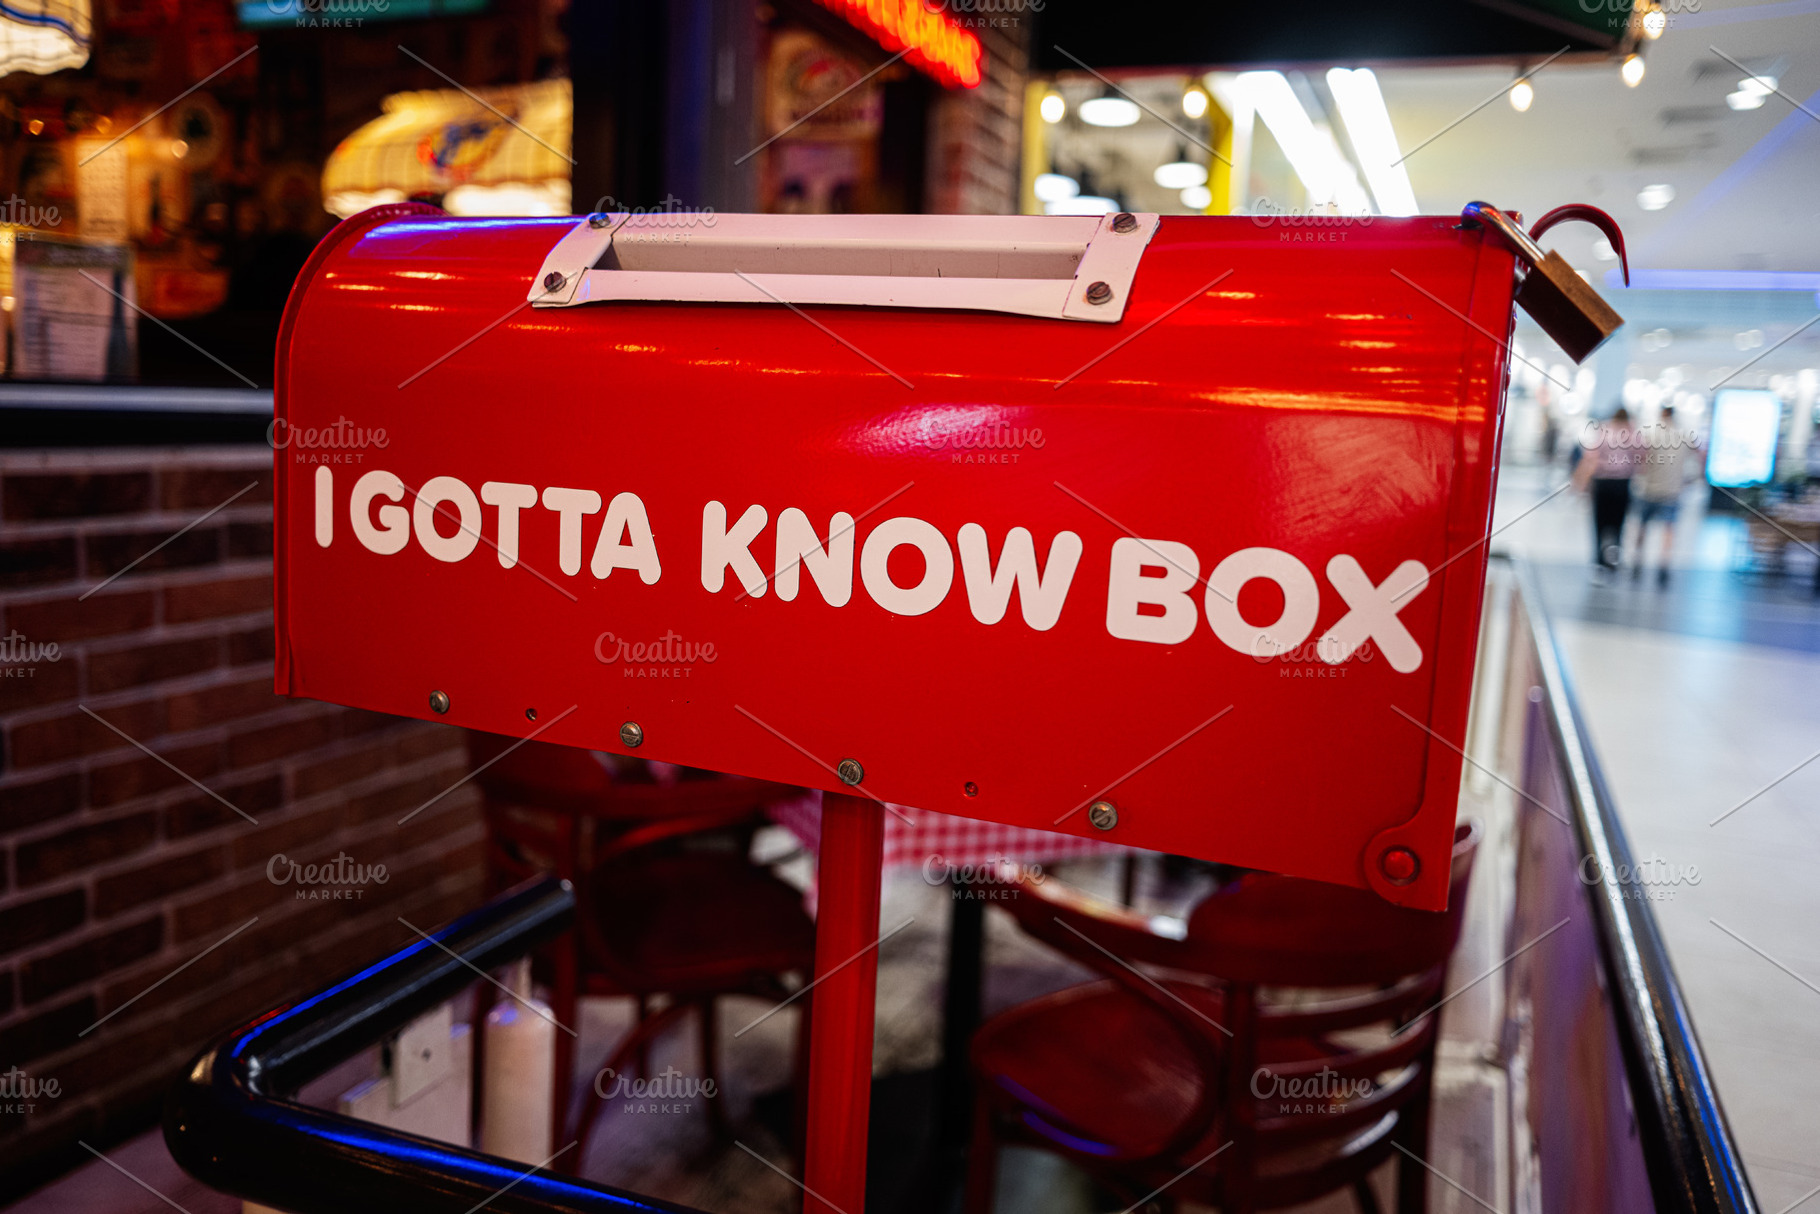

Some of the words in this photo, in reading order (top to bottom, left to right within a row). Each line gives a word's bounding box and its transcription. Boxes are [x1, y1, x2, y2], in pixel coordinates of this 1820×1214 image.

[315, 465, 333, 548] I
[349, 470, 662, 585] GOTTA
[700, 500, 1083, 632] KNOW
[1105, 537, 1430, 674] BOX
